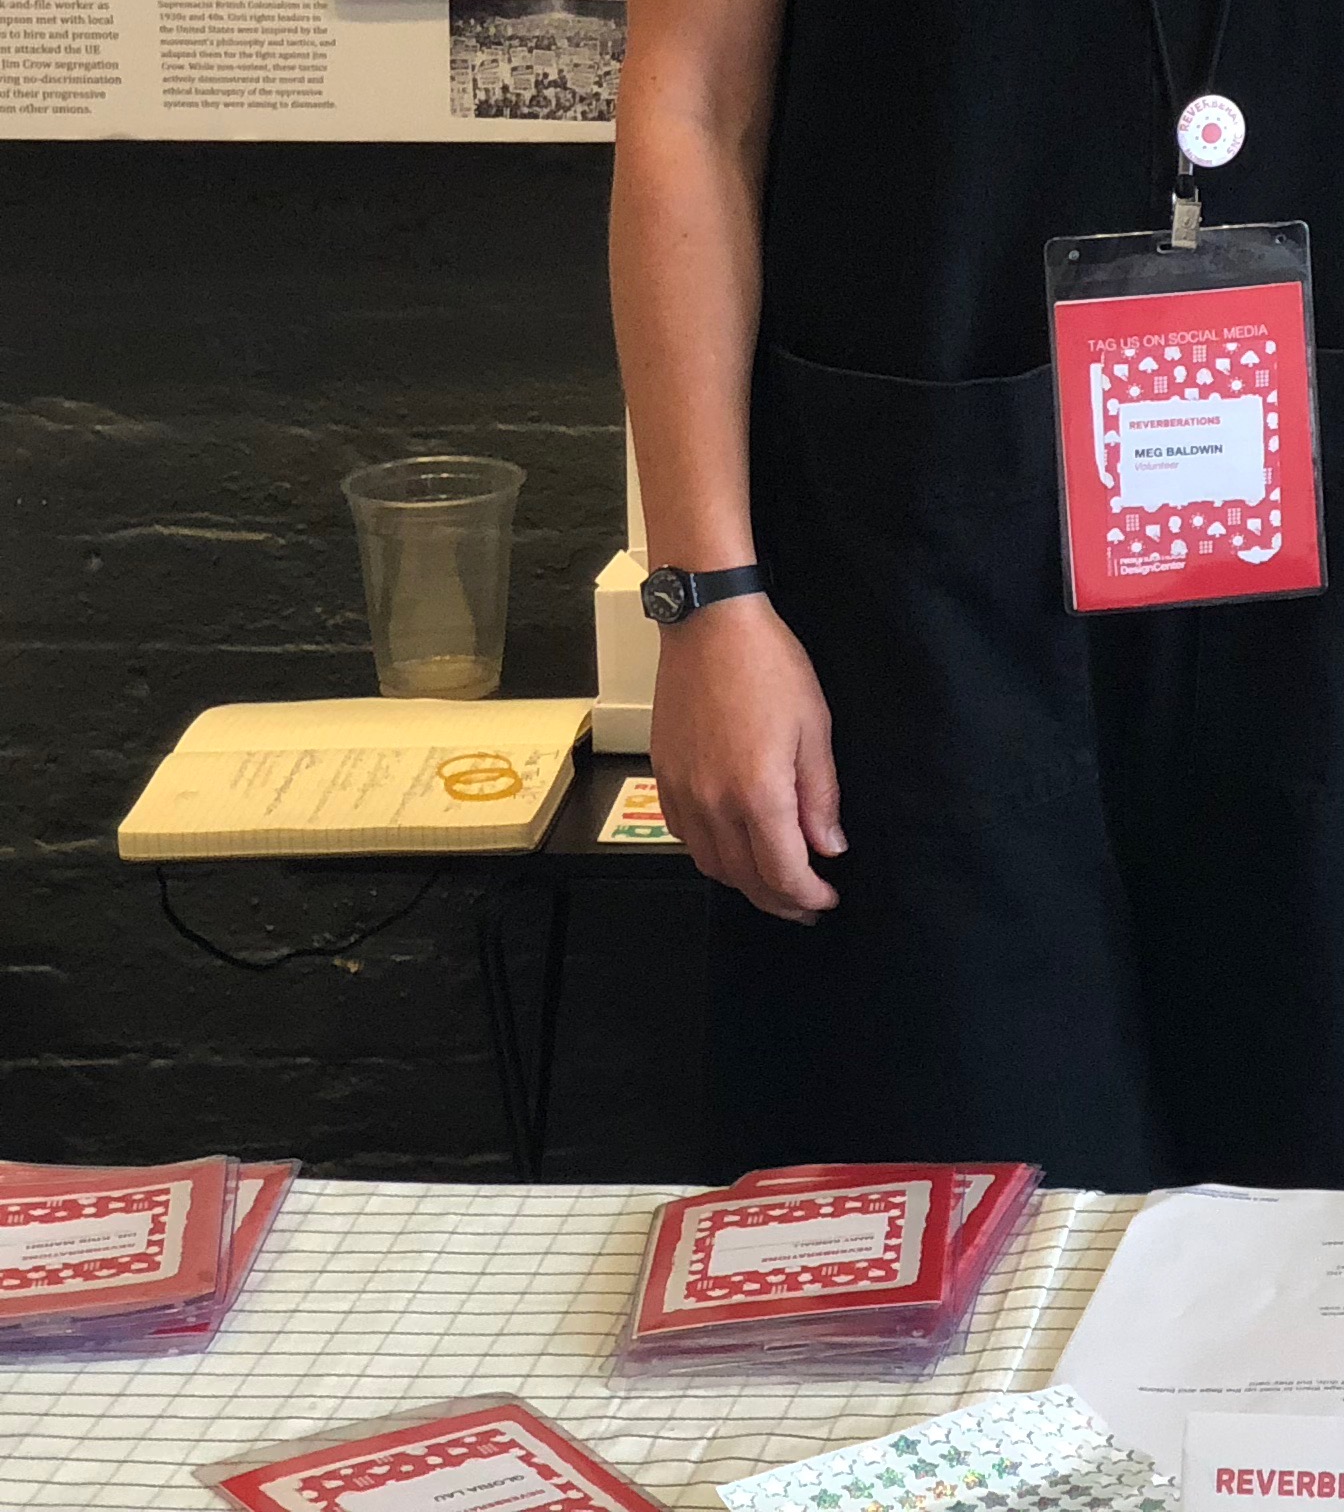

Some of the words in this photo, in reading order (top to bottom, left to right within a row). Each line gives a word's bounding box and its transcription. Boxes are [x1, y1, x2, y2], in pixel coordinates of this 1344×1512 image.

[1088, 338, 1117, 354] TAG
[1120, 336, 1140, 351] US
[1142, 333, 1165, 348] ON
[1168, 329, 1219, 346] SOCIAL
[1223, 324, 1269, 340] MEDIA
[1128, 415, 1221, 431] REVERBERATIONS
[1134, 446, 1164, 459] MEG
[1166, 443, 1223, 457] BALDWIN
[466, 1474, 525, 1493] GLORIA
